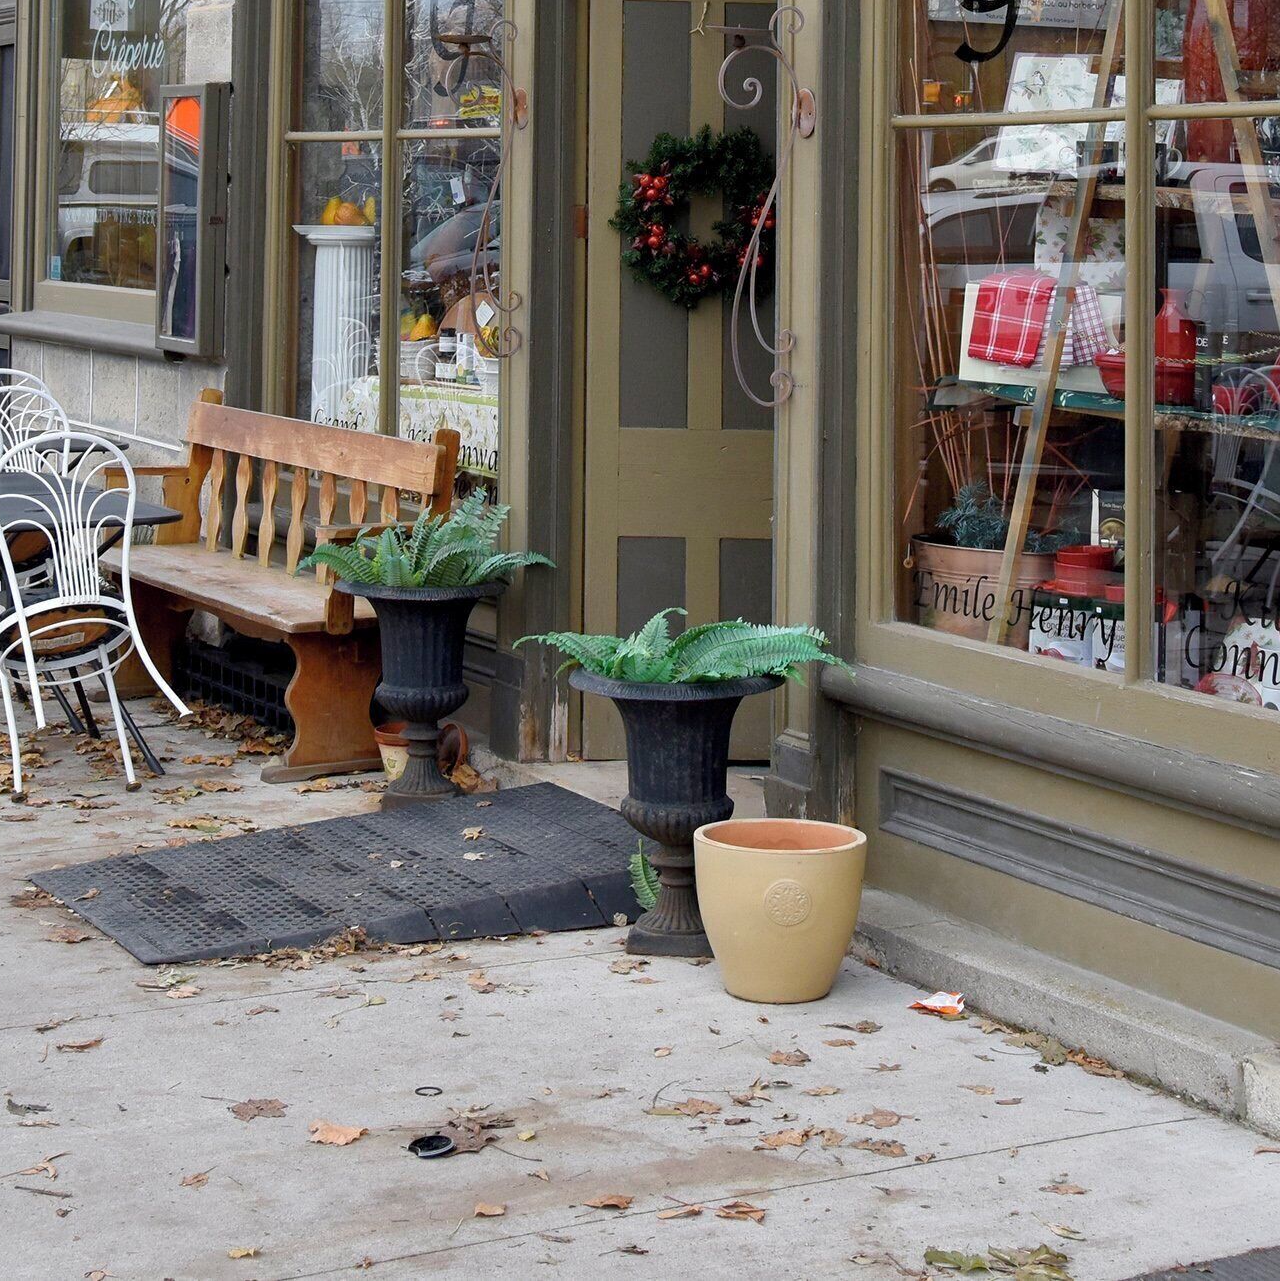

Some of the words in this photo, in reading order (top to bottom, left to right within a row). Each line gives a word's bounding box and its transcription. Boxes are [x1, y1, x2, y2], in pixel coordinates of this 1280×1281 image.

[91, 20, 166, 86] Crêperie
[912, 570, 996, 622] Emile
[1006, 586, 1118, 667] Henry
